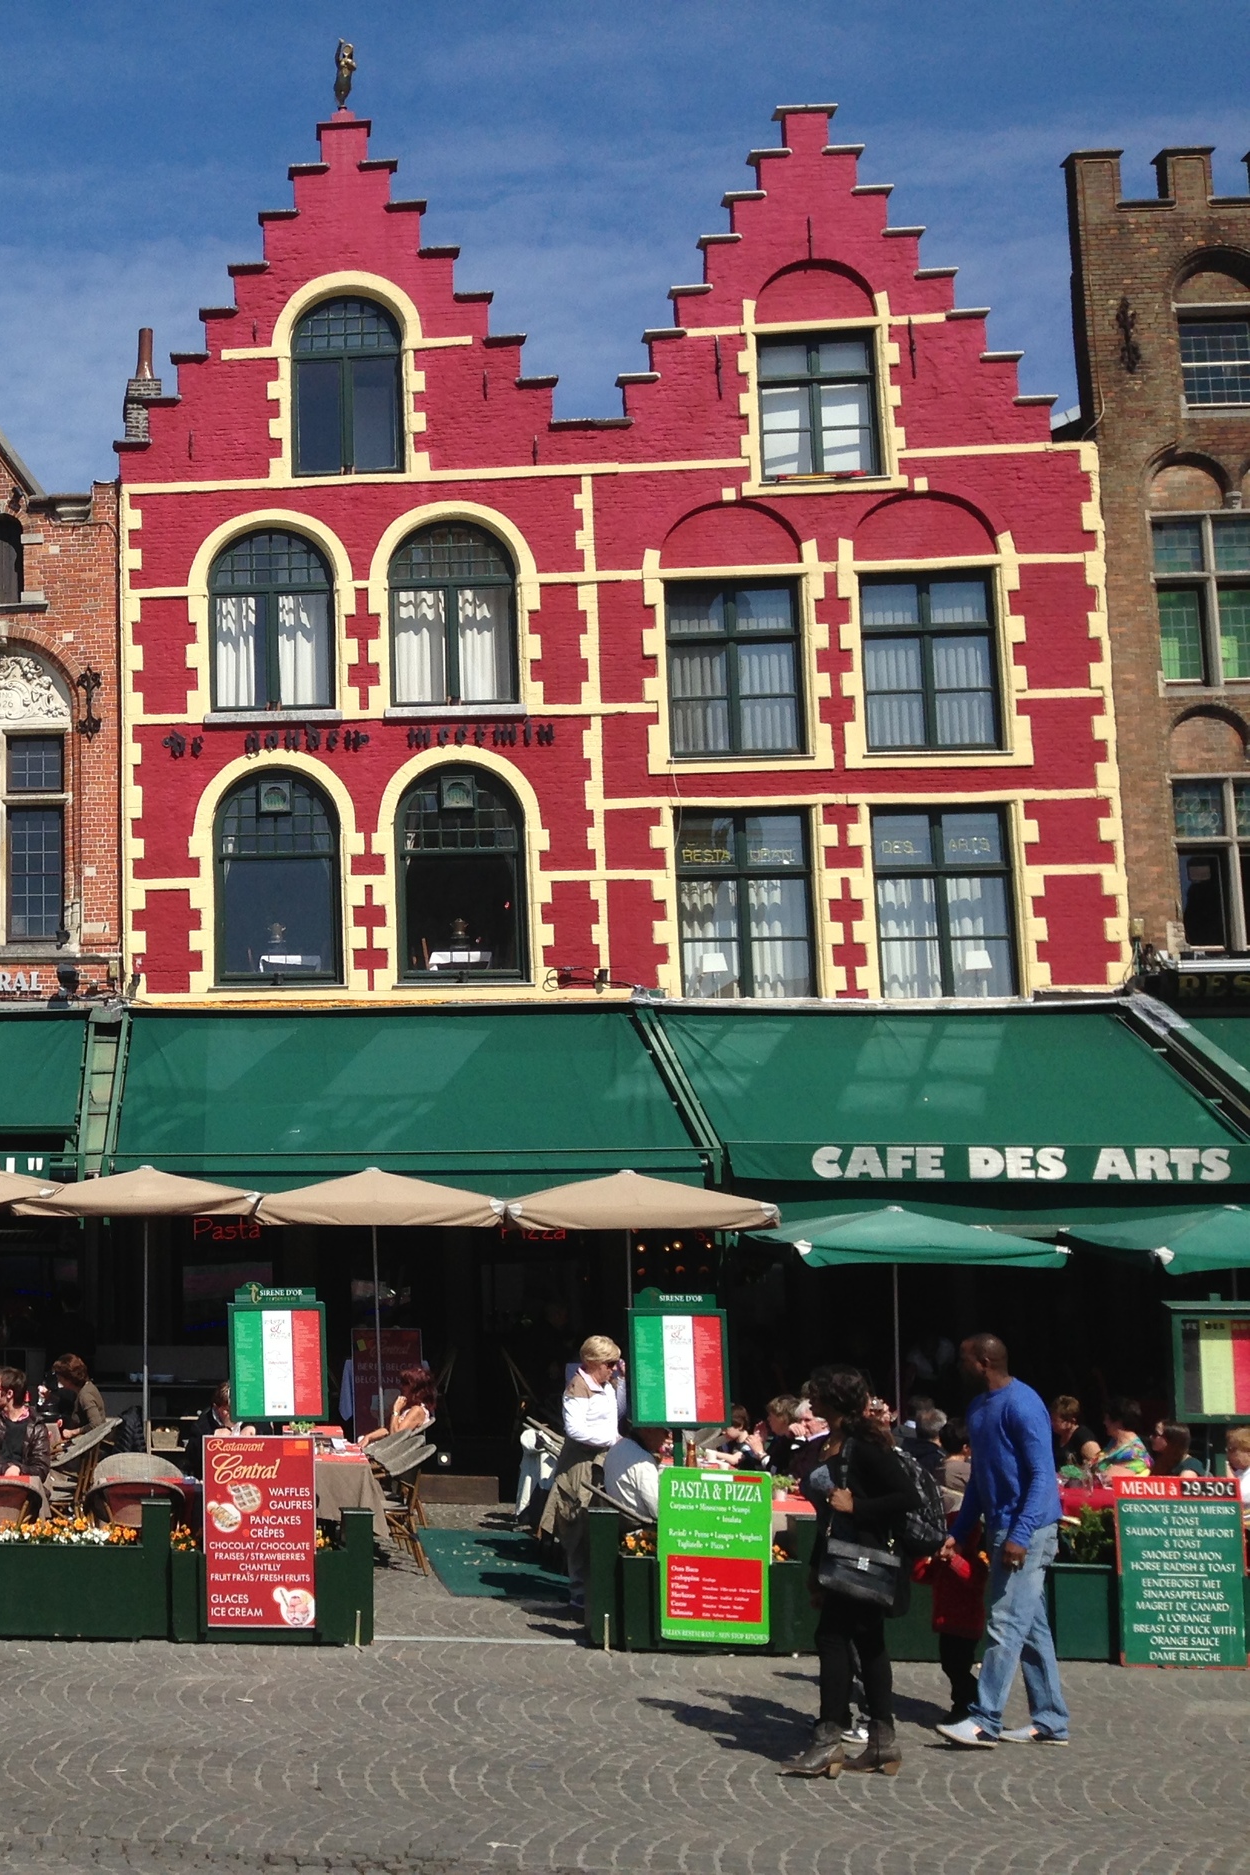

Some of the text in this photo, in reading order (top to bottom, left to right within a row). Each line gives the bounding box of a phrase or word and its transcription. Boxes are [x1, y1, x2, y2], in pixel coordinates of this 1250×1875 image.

[682, 848, 731, 863] RESTA
[811, 1146, 1232, 1182] CAFE DES ARTS
[193, 1216, 261, 1241] Pasta
[259, 1289, 303, 1297] SIRENE D'OR
[659, 1295, 685, 1303] SIRENE
[355, 1375, 394, 1385] BELGAN
[207, 1439, 265, 1452] Restaurant
[211, 1453, 281, 1484] Central
[269, 1487, 310, 1497] WAFFLES
[670, 1480, 762, 1503] PASTA & PIZZA
[1121, 1481, 1165, 1495] MENU
[1169, 1482, 1177, 1496] à
[269, 1500, 313, 1510] GAUFRES
[670, 1501, 694, 1511] Carpaccio
[731, 1505, 750, 1515] Scampi
[1121, 1503, 1236, 1515] GEROOKTE ZALM MIERIKS
[250, 1515, 301, 1525] PANCAKES
[1171, 1516, 1200, 1526] TOAST
[250, 1526, 285, 1538] CRÊPES
[1125, 1527, 1235, 1538] SAUMON FUME RAIFORT
[209, 1541, 310, 1551] CHOCOLAT CHOCOLATE
[1173, 1539, 1201, 1549] TOAST
[214, 1552, 306, 1561] FRAISES STRAWBERRIES
[1141, 1550, 1223, 1561] SMOKED SALMON
[239, 1562, 281, 1571] CHANTILLY
[1131, 1561, 1161, 1571] HORSE
[1163, 1562, 1197, 1572] RADISH
[1208, 1563, 1236, 1573] TOAST
[210, 1573, 231, 1582] FRUIT
[260, 1573, 283, 1582] FRESH
[285, 1573, 310, 1582] FRUITS
[1141, 1578, 1222, 1589] EENDEBORST MET
[211, 1593, 249, 1604] GLACES
[1142, 1589, 1225, 1600] SINAASAPPELSAUS
[211, 1607, 263, 1617] ICE CREAM
[1136, 1601, 1230, 1612] MAGRET DE CANARD
[1157, 1613, 1211, 1624] A L'ORANGE
[1133, 1623, 1237, 1635] BREAST OF DUCK WITH
[1149, 1635, 1220, 1647] ORANGE SAUCE
[1149, 1651, 1221, 1662] DAME BLANCHE
